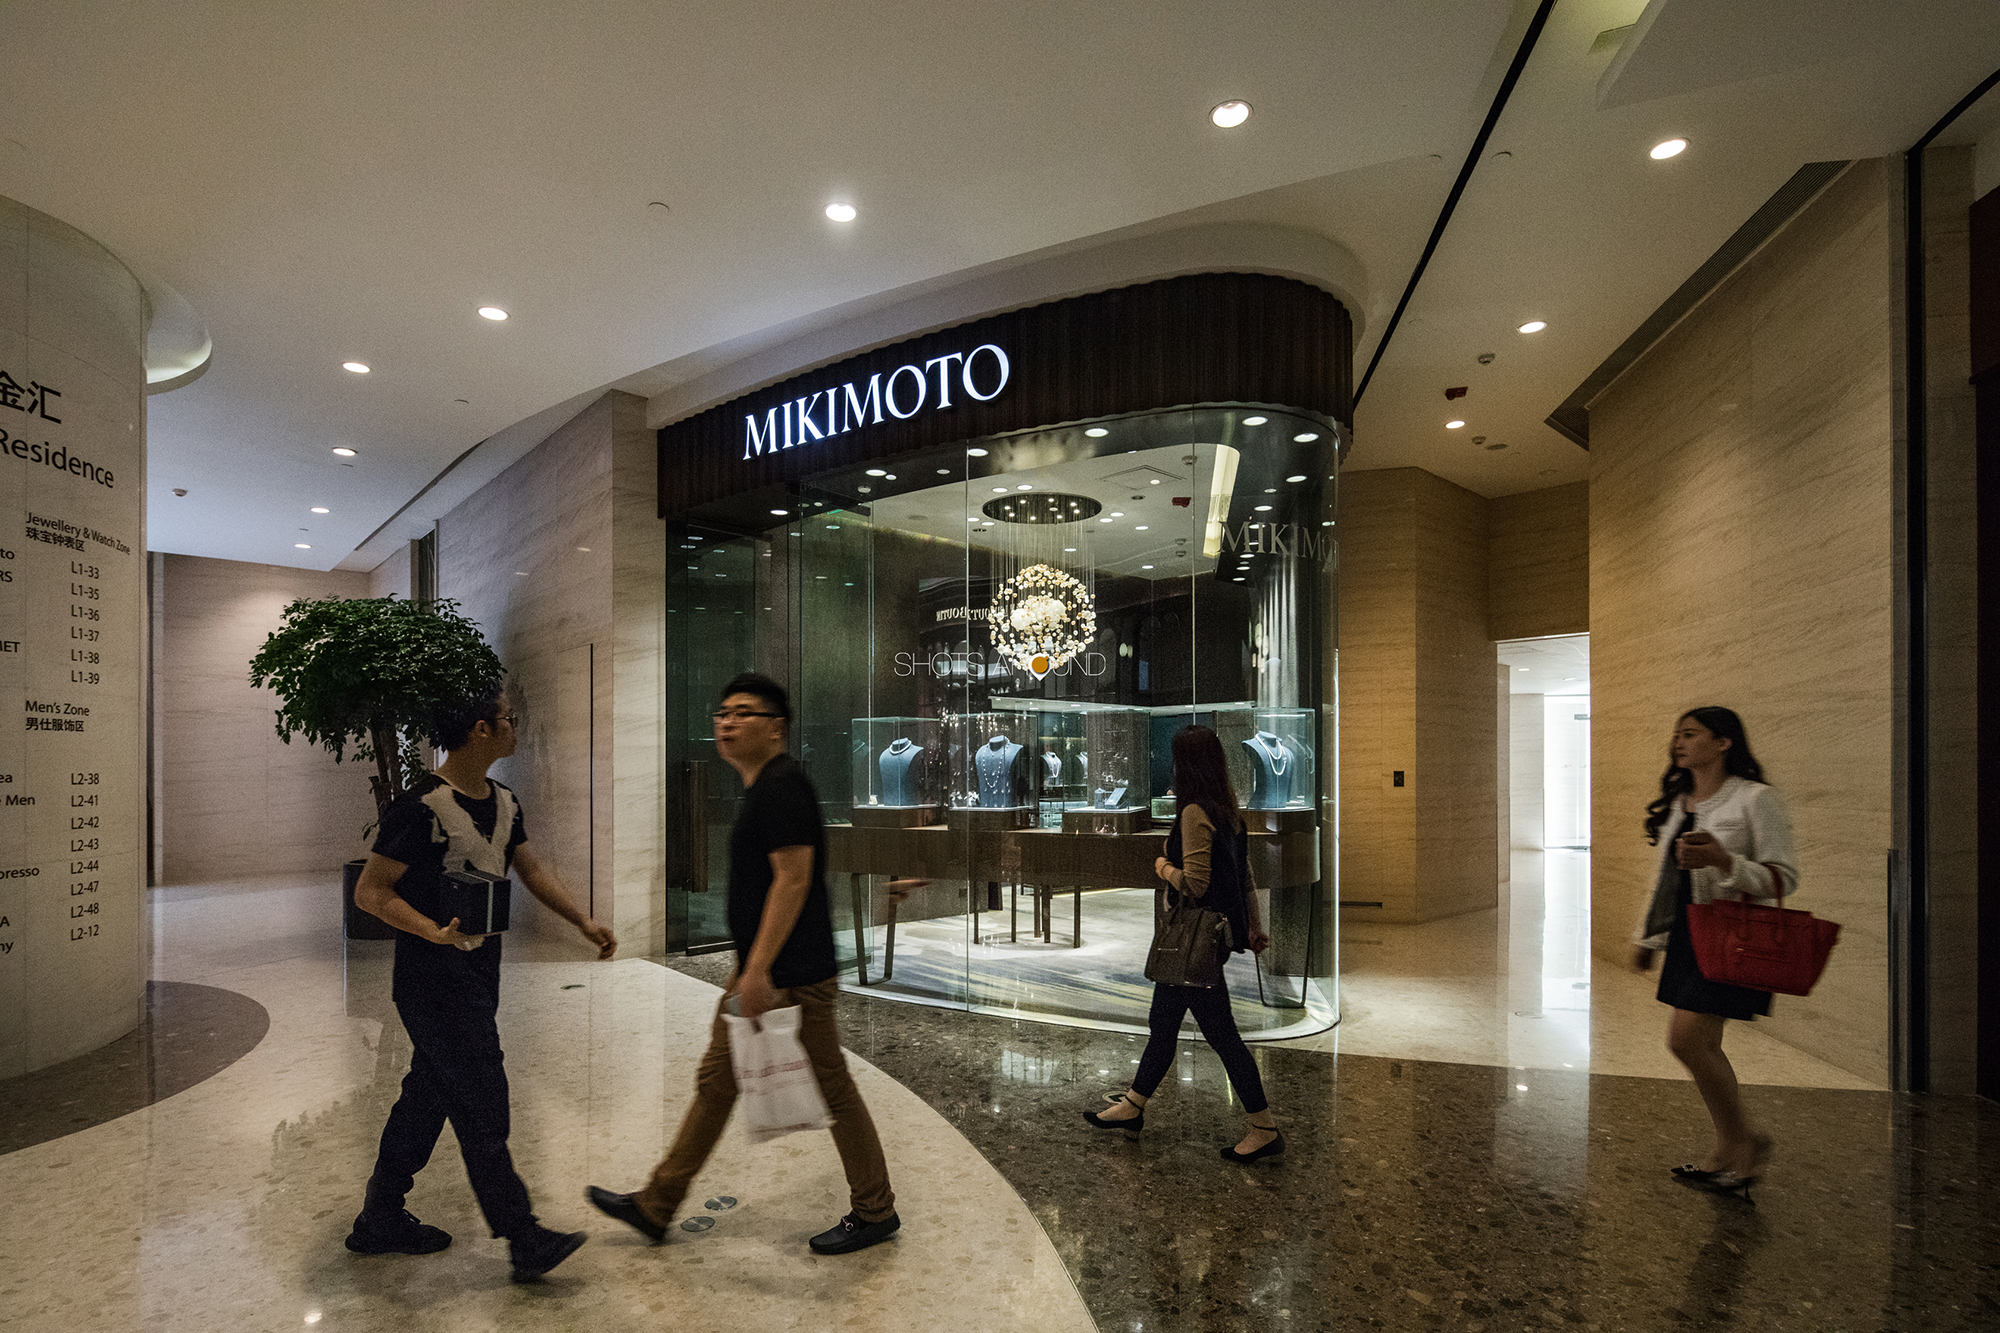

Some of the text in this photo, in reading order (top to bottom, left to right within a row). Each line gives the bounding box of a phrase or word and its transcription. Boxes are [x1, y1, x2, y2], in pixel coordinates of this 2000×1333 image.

[742, 343, 1010, 461] MIKIMOTO
[25, 512, 130, 555] Jewellery & Watch Zone
[25, 526, 85, 552] 珠宝钟表区
[71, 561, 100, 579] L1-33
[71, 583, 100, 600] L1-35
[71, 605, 100, 621] L1-36
[71, 627, 100, 642] L1-37
[0, 640, 21, 653] ET
[71, 649, 100, 665] L1-38
[71, 670, 100, 685] L1-39
[25, 700, 90, 716] Men's Zone
[25, 717, 85, 732] 男仕服饰区
[71, 773, 100, 785] L2-38
[5, 794, 36, 806] Men
[71, 795, 99, 807] L2-41
[71, 817, 100, 829] L2-42
[71, 838, 100, 852] L2-43
[71, 861, 99, 874] L2-44
[71, 881, 99, 896] L2-47
[71, 903, 100, 918] L2-48
[71, 925, 100, 941] L2-12
